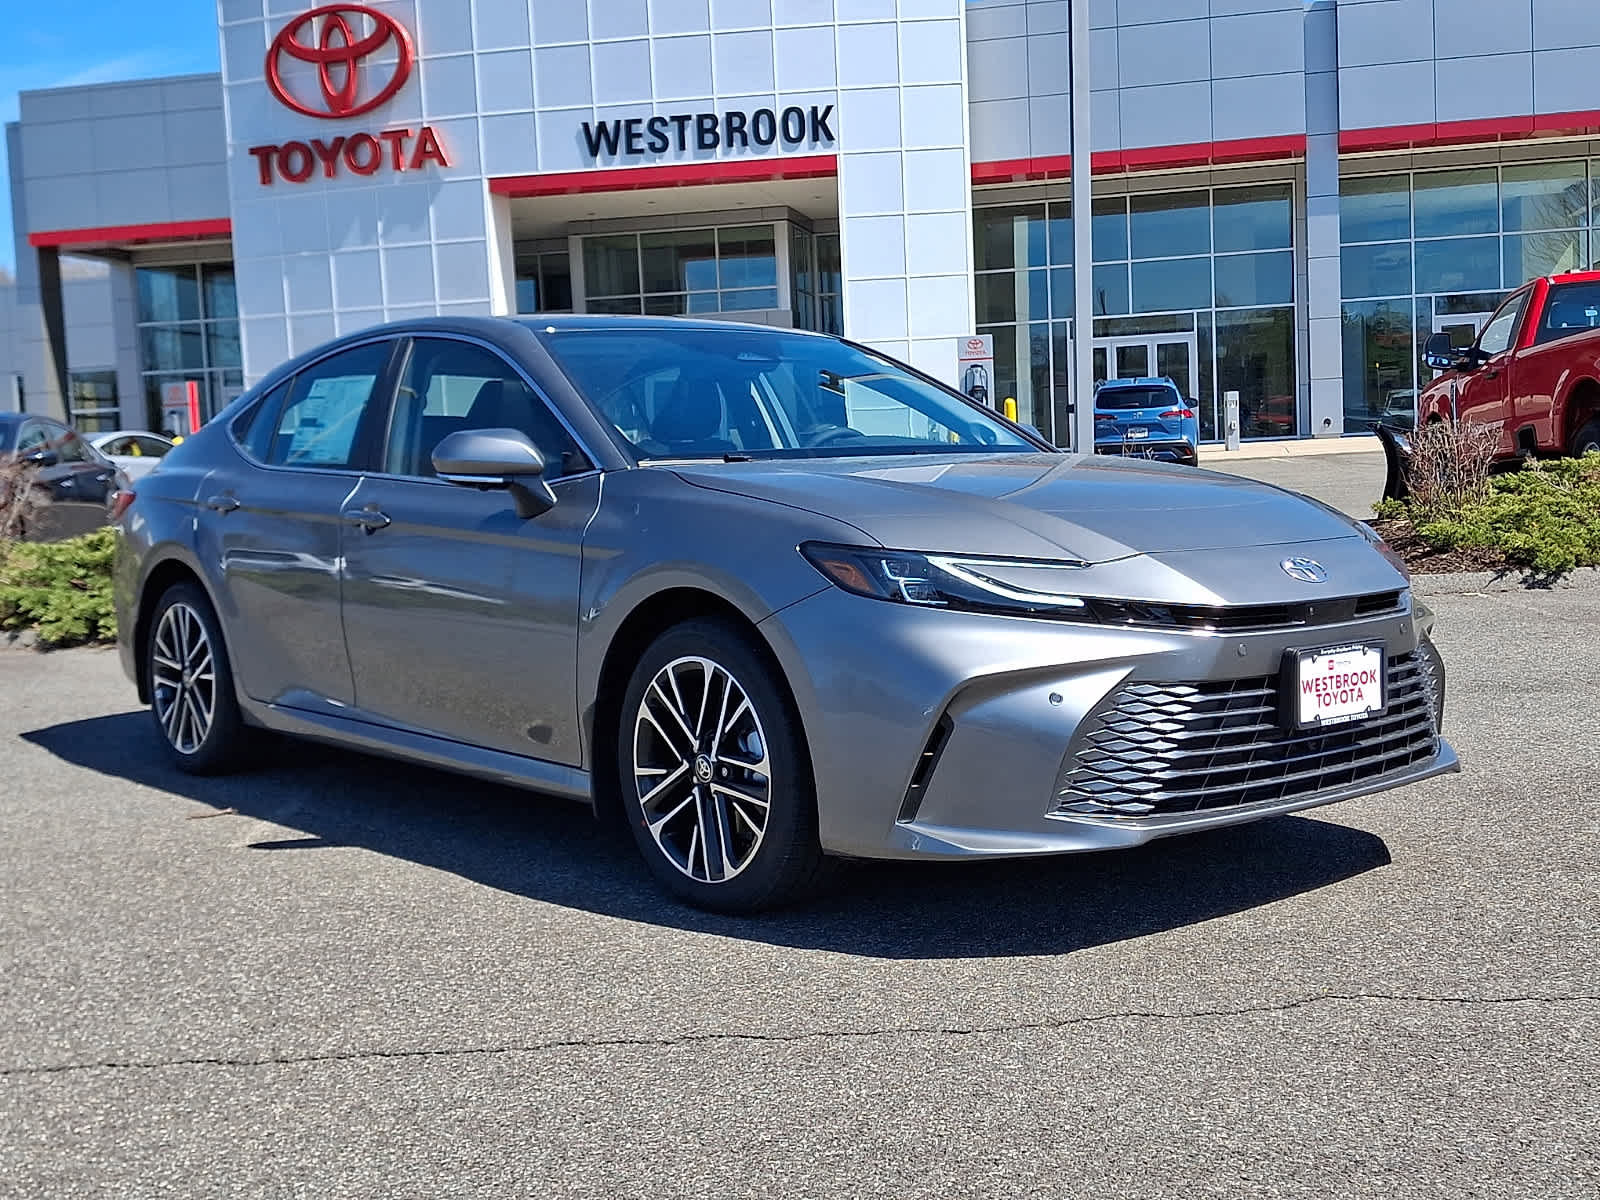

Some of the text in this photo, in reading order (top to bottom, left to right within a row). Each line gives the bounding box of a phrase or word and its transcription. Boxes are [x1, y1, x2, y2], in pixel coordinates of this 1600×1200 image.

[581, 104, 836, 159] WESTBROOK
[248, 126, 450, 186] TOYOTA
[1301, 668, 1377, 694] WESTBROOK
[1315, 687, 1364, 709] TOYOTA
